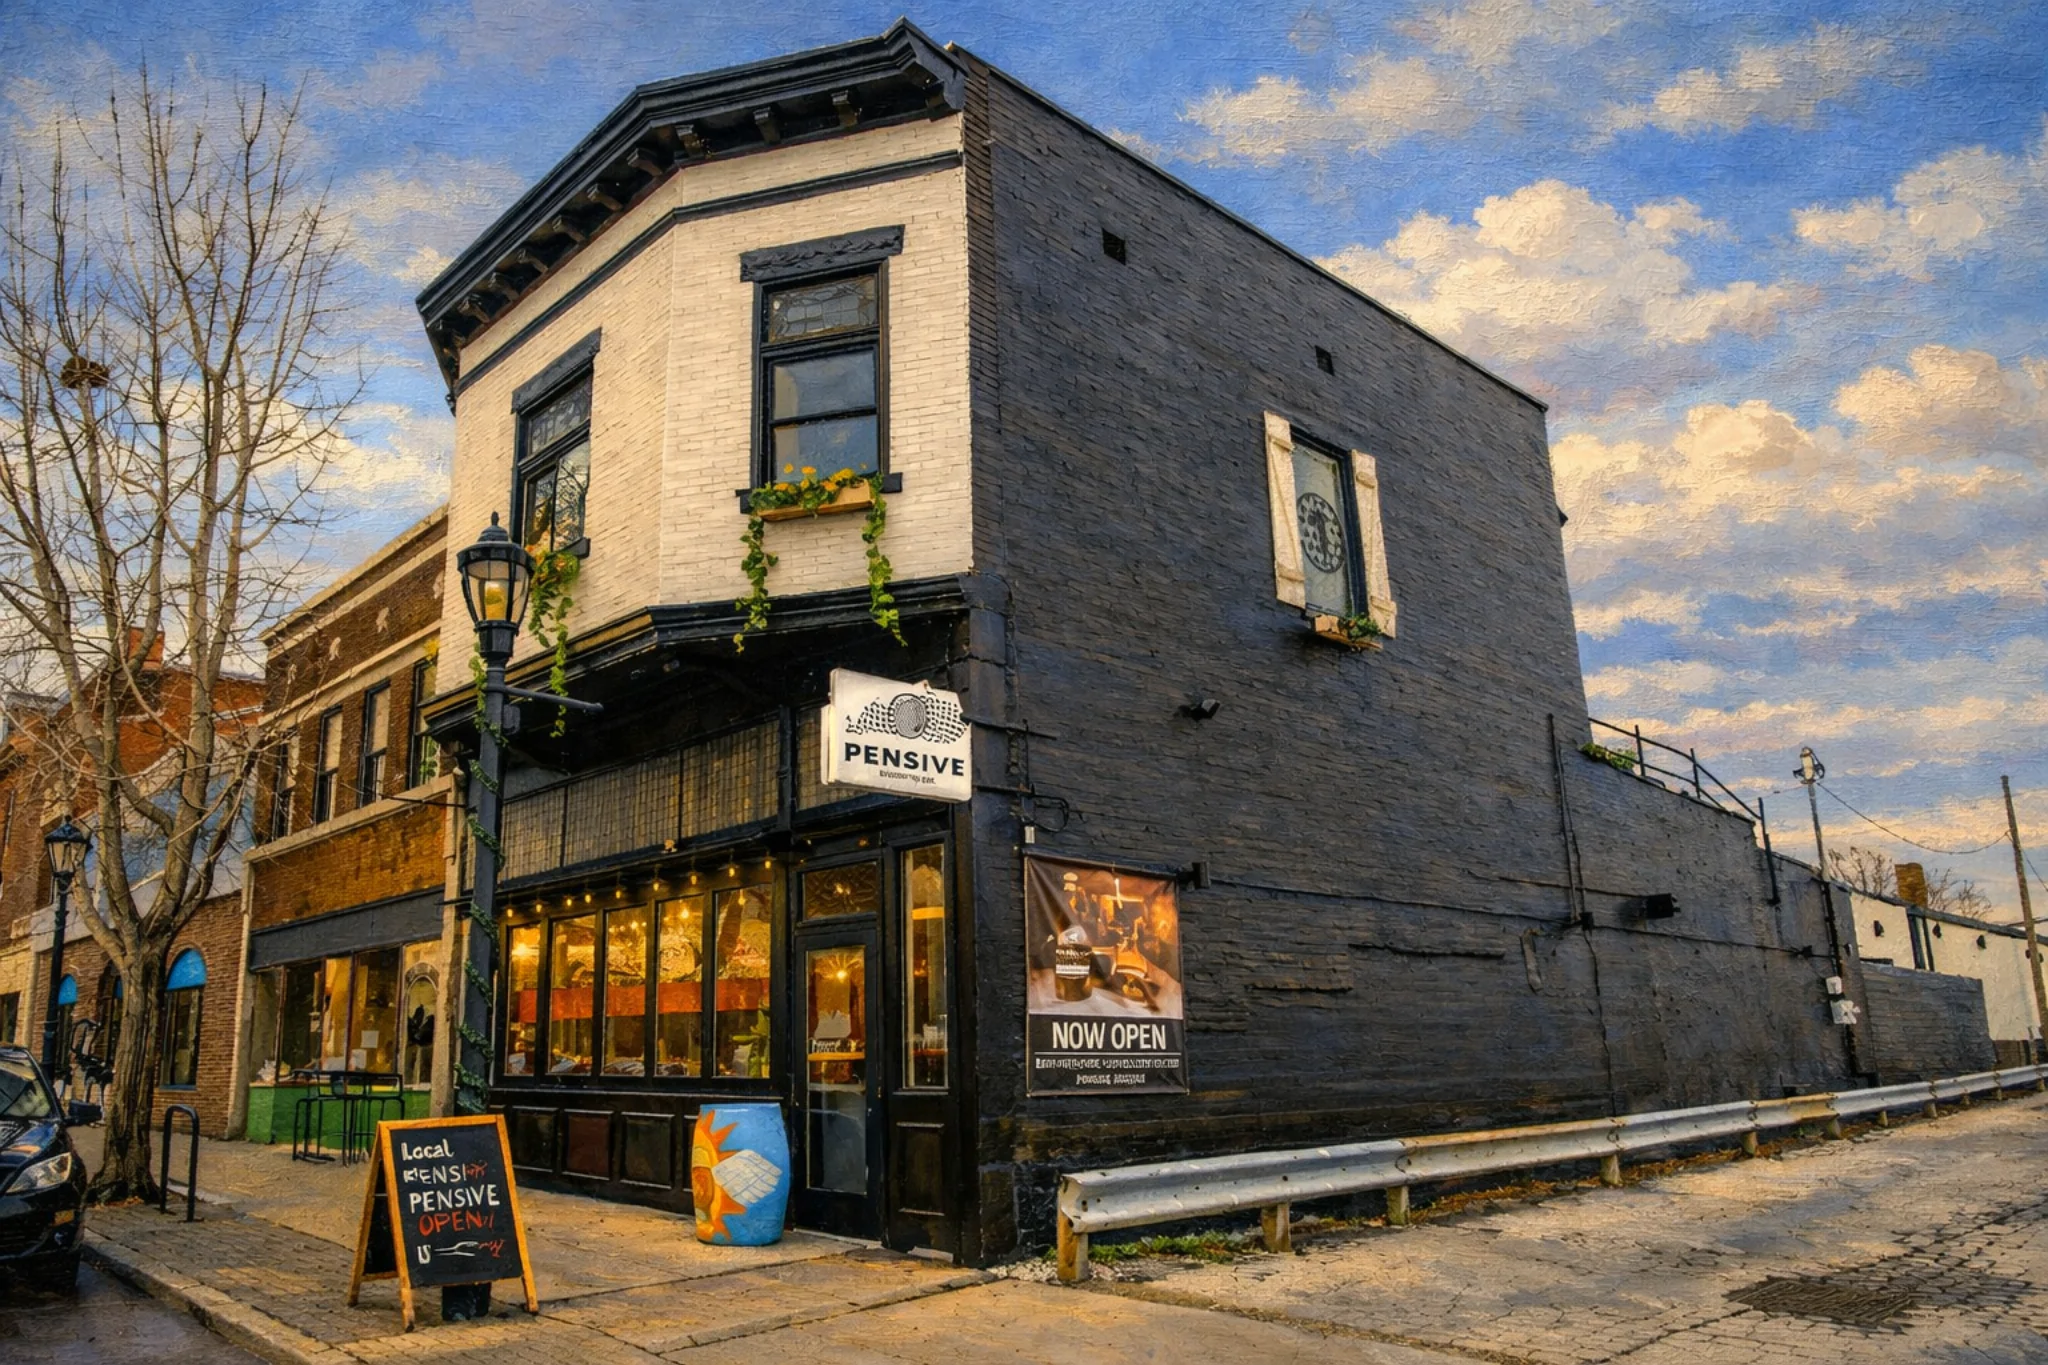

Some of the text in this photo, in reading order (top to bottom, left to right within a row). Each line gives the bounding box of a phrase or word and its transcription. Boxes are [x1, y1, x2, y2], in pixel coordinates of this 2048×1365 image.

[844, 742, 965, 776] PENSIVE
[1052, 1021, 1166, 1050] NOW OPEN
[409, 1184, 500, 1214] PENSIVE
